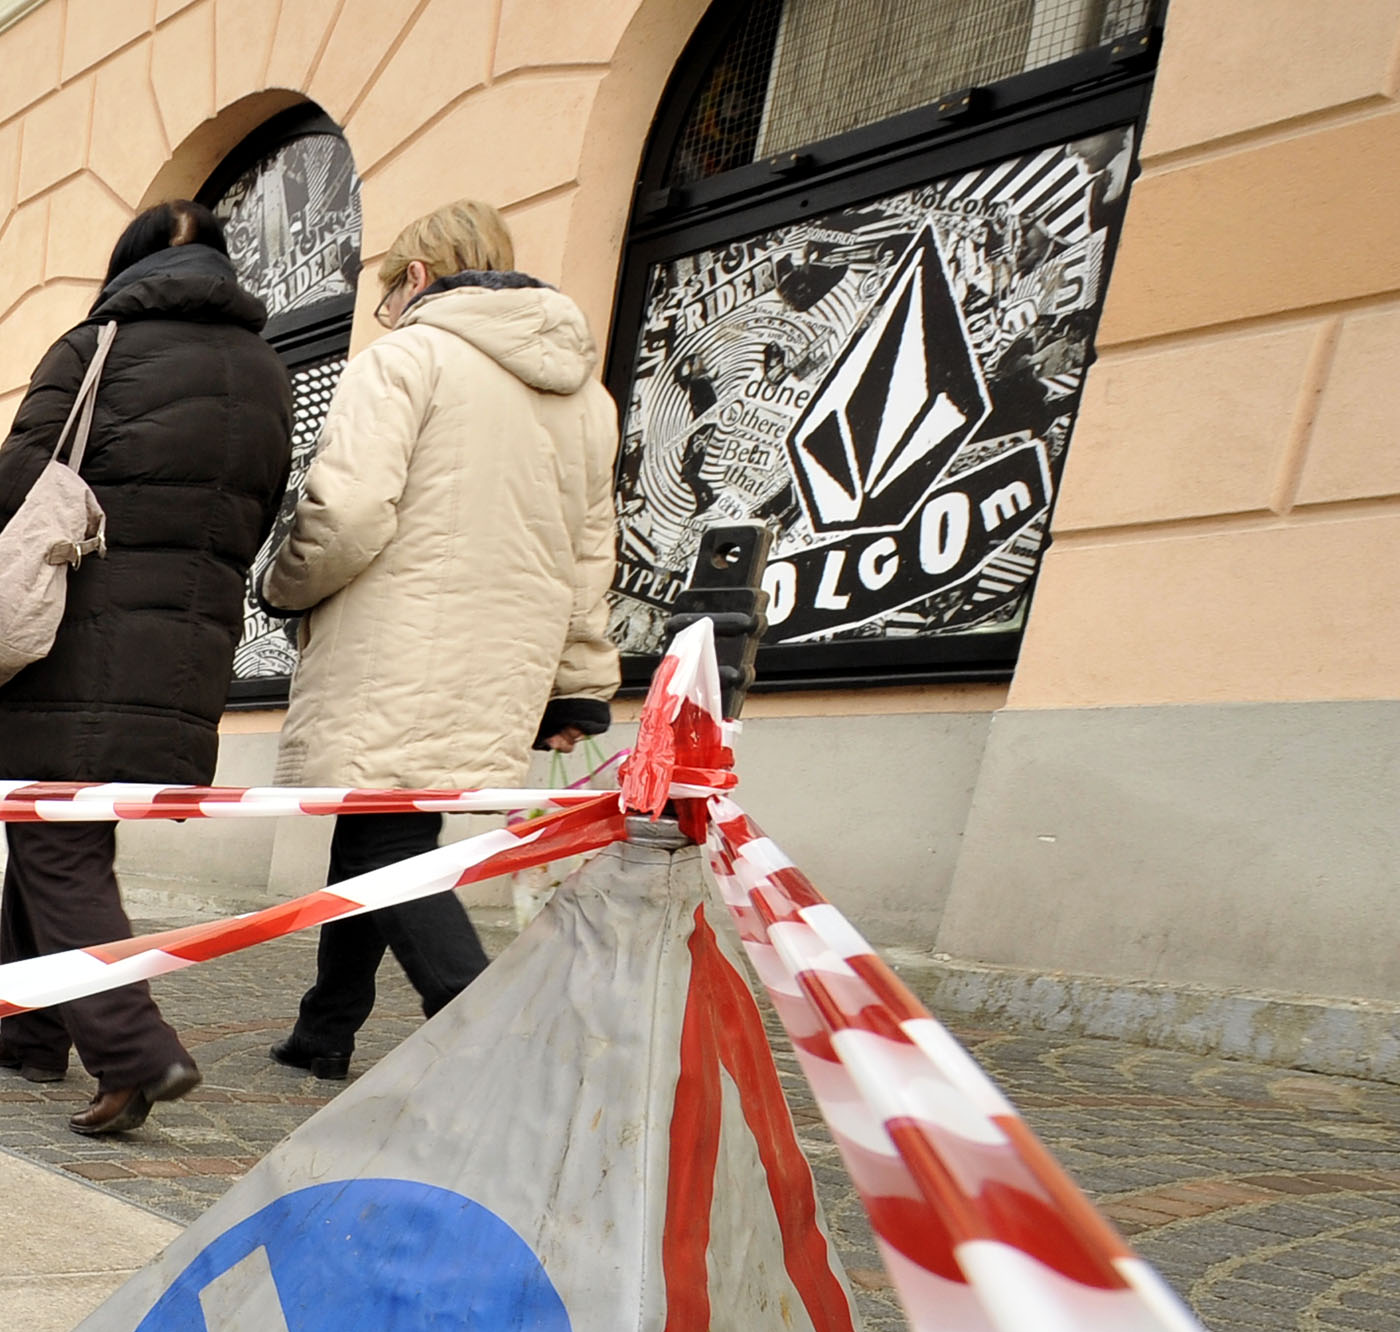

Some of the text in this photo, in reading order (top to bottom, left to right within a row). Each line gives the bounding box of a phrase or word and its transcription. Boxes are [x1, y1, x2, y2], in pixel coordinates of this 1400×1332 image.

[273, 244, 340, 315] RIDER
[684, 260, 776, 336] RIDER
[744, 375, 811, 410] done
